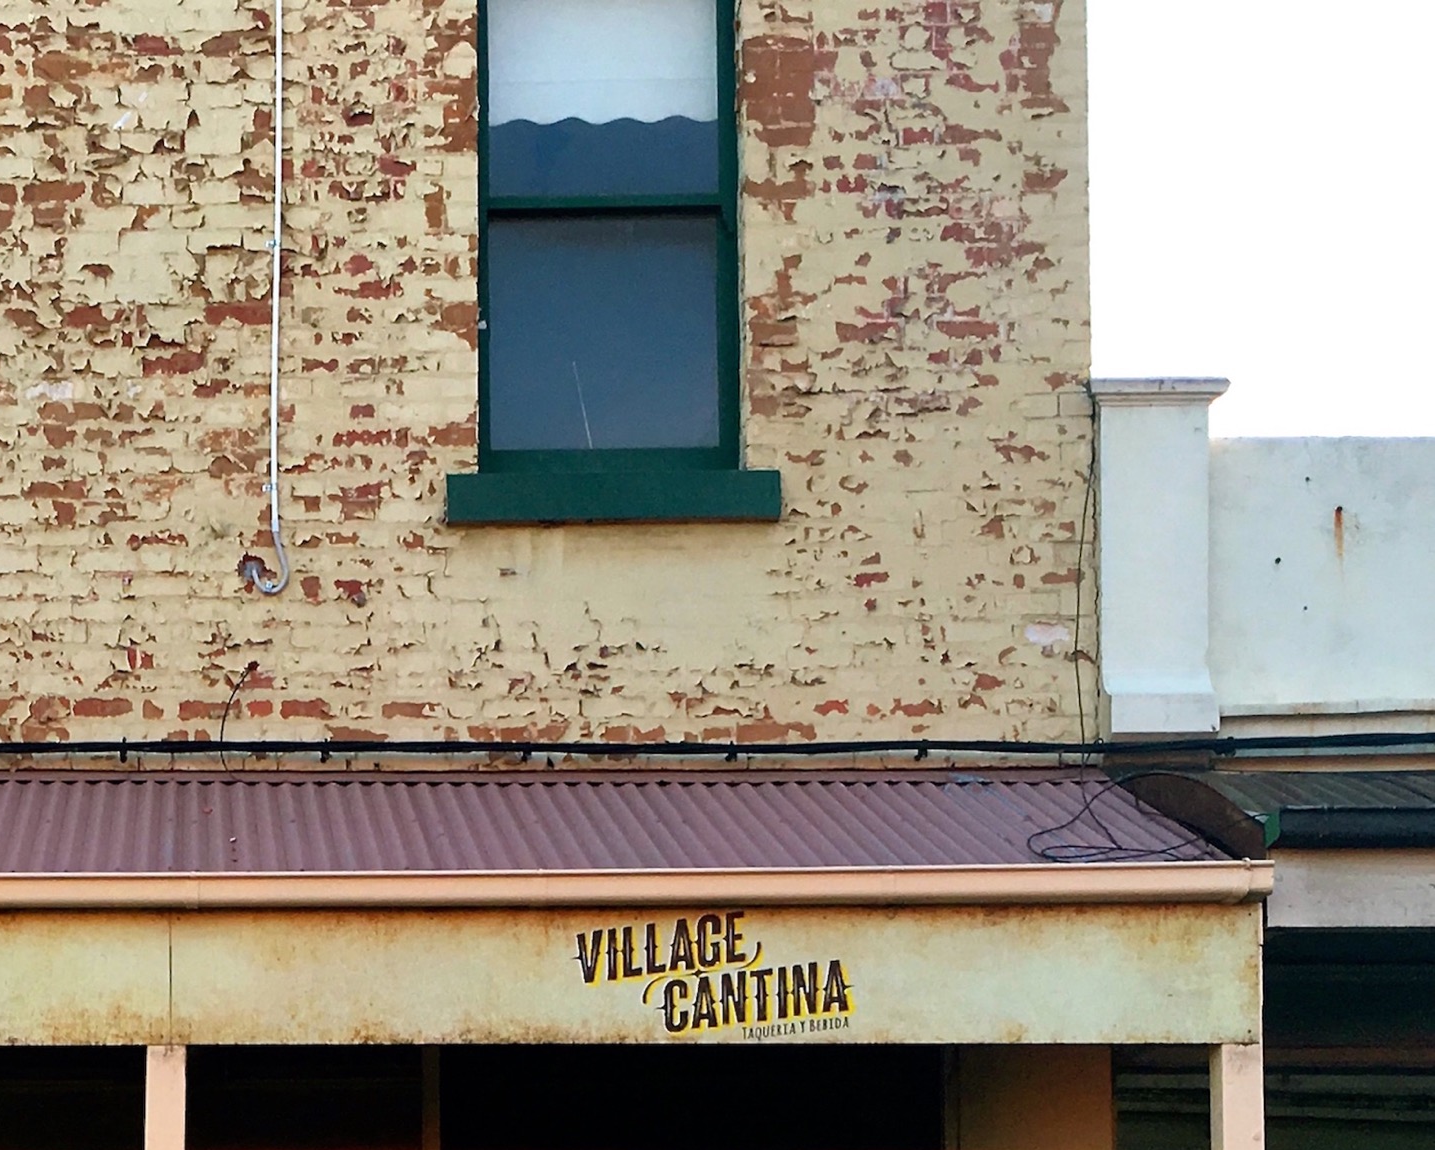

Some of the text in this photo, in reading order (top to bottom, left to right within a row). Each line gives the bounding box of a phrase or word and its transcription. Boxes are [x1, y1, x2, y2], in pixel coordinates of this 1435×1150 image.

[574, 910, 746, 984] VILLAGE
[660, 959, 852, 1033] CANTINA
[741, 1016, 850, 1040] TAQUERIA Y BEBIDA
